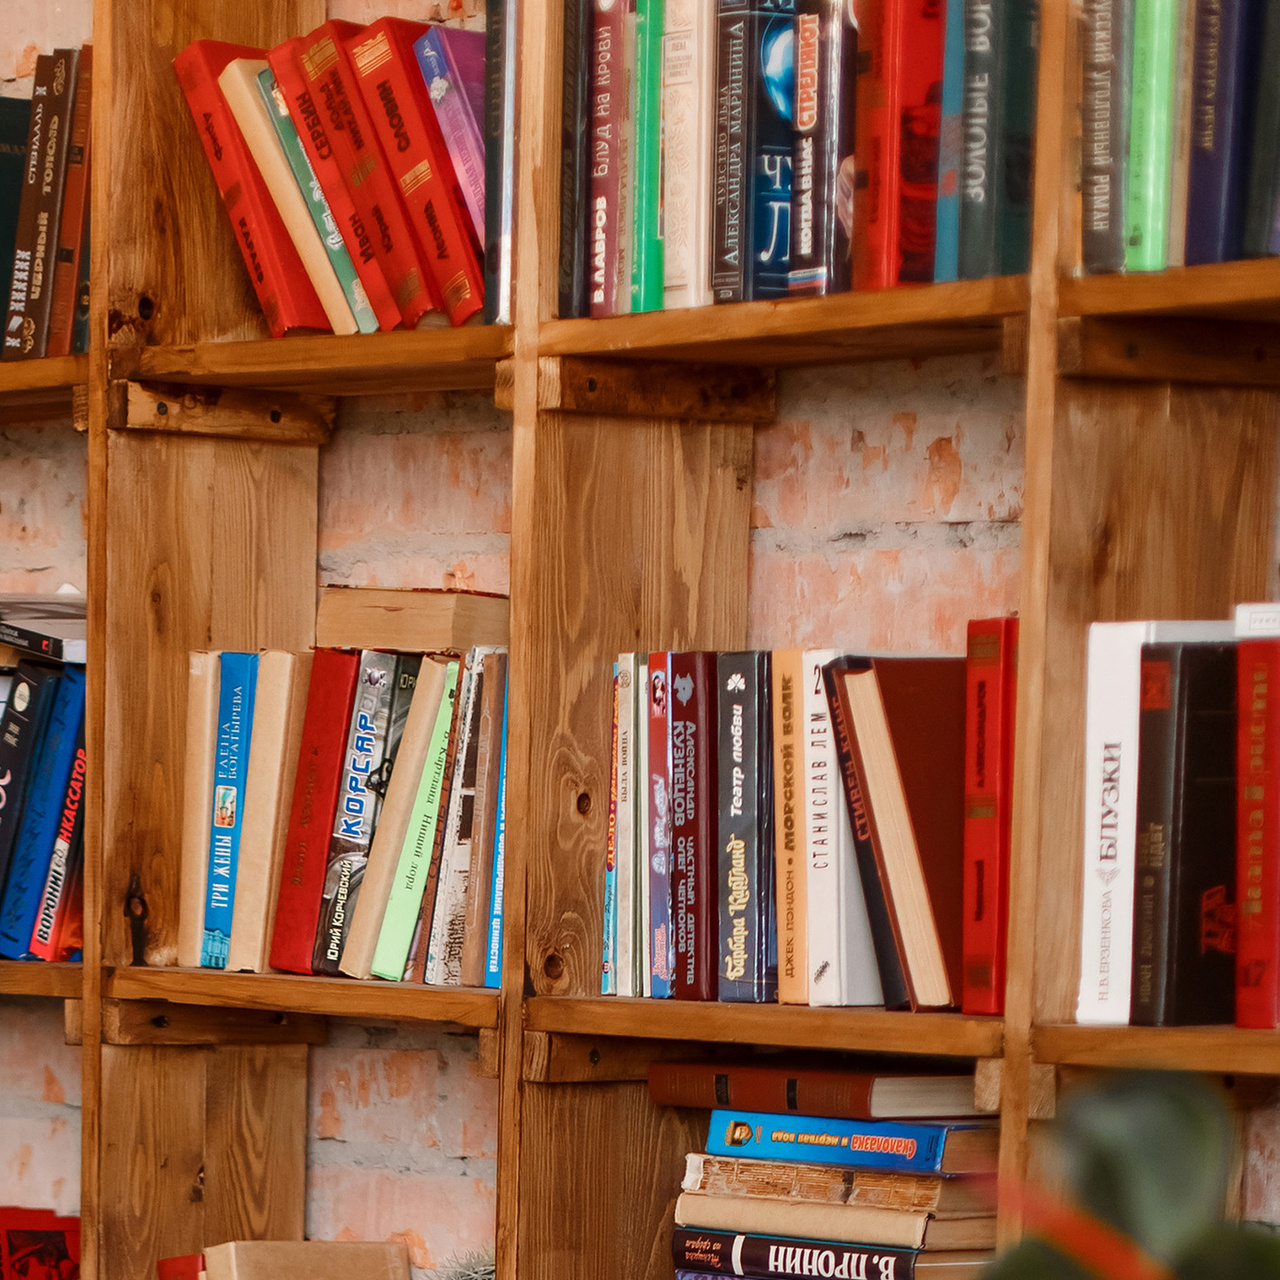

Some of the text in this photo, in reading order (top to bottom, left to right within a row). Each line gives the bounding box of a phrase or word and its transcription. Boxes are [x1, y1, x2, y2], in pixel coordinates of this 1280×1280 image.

[376, 79, 411, 153] СЛОВИН
[797, 13, 821, 131] СТРЕЛЯЮТ
[27, 102, 44, 184] СТЕНДАЛЬ
[295, 90, 333, 161] СЕРБИН
[716, 85, 730, 206] ЧУВСТВО ЛЬДА
[1091, 69, 1114, 231] УГОЛОВНЫЙ РОМАН
[348, 213, 375, 266] Иван
[423, 199, 450, 261] Леонид
[217, 721, 231, 779] ЕЛЕНА
[227, 684, 244, 780] БОГАТЫРЕВА
[338, 710, 378, 837] КОРСАР
[672, 720, 686, 827] КУЗНЕЦОВ
[729, 703, 745, 817] Театр любви
[404, 746, 448, 892] Картланд Нищий лорд
[605, 812, 618, 867] ДЕЛО
[779, 671, 796, 979] ДЖЕК МОРСКОЙ ВОЛК
[809, 711, 829, 870] СТАНИСЛАВ ЛЕМ
[1098, 741, 1122, 863] БЛУЗКИ
[210, 833, 232, 909] ТРИ ЖЕНЫ
[677, 835, 687, 874] ОЛЕГ
[488, 917, 503, 973] ЦЕННОСТЕЙ
[685, 835, 696, 986] ЧАСТНЫЙ ДЕТЕКТИВ
[724, 831, 751, 982] Барбара Картланд
[770, 1130, 917, 1161] Скалолазка и мертвая вода
